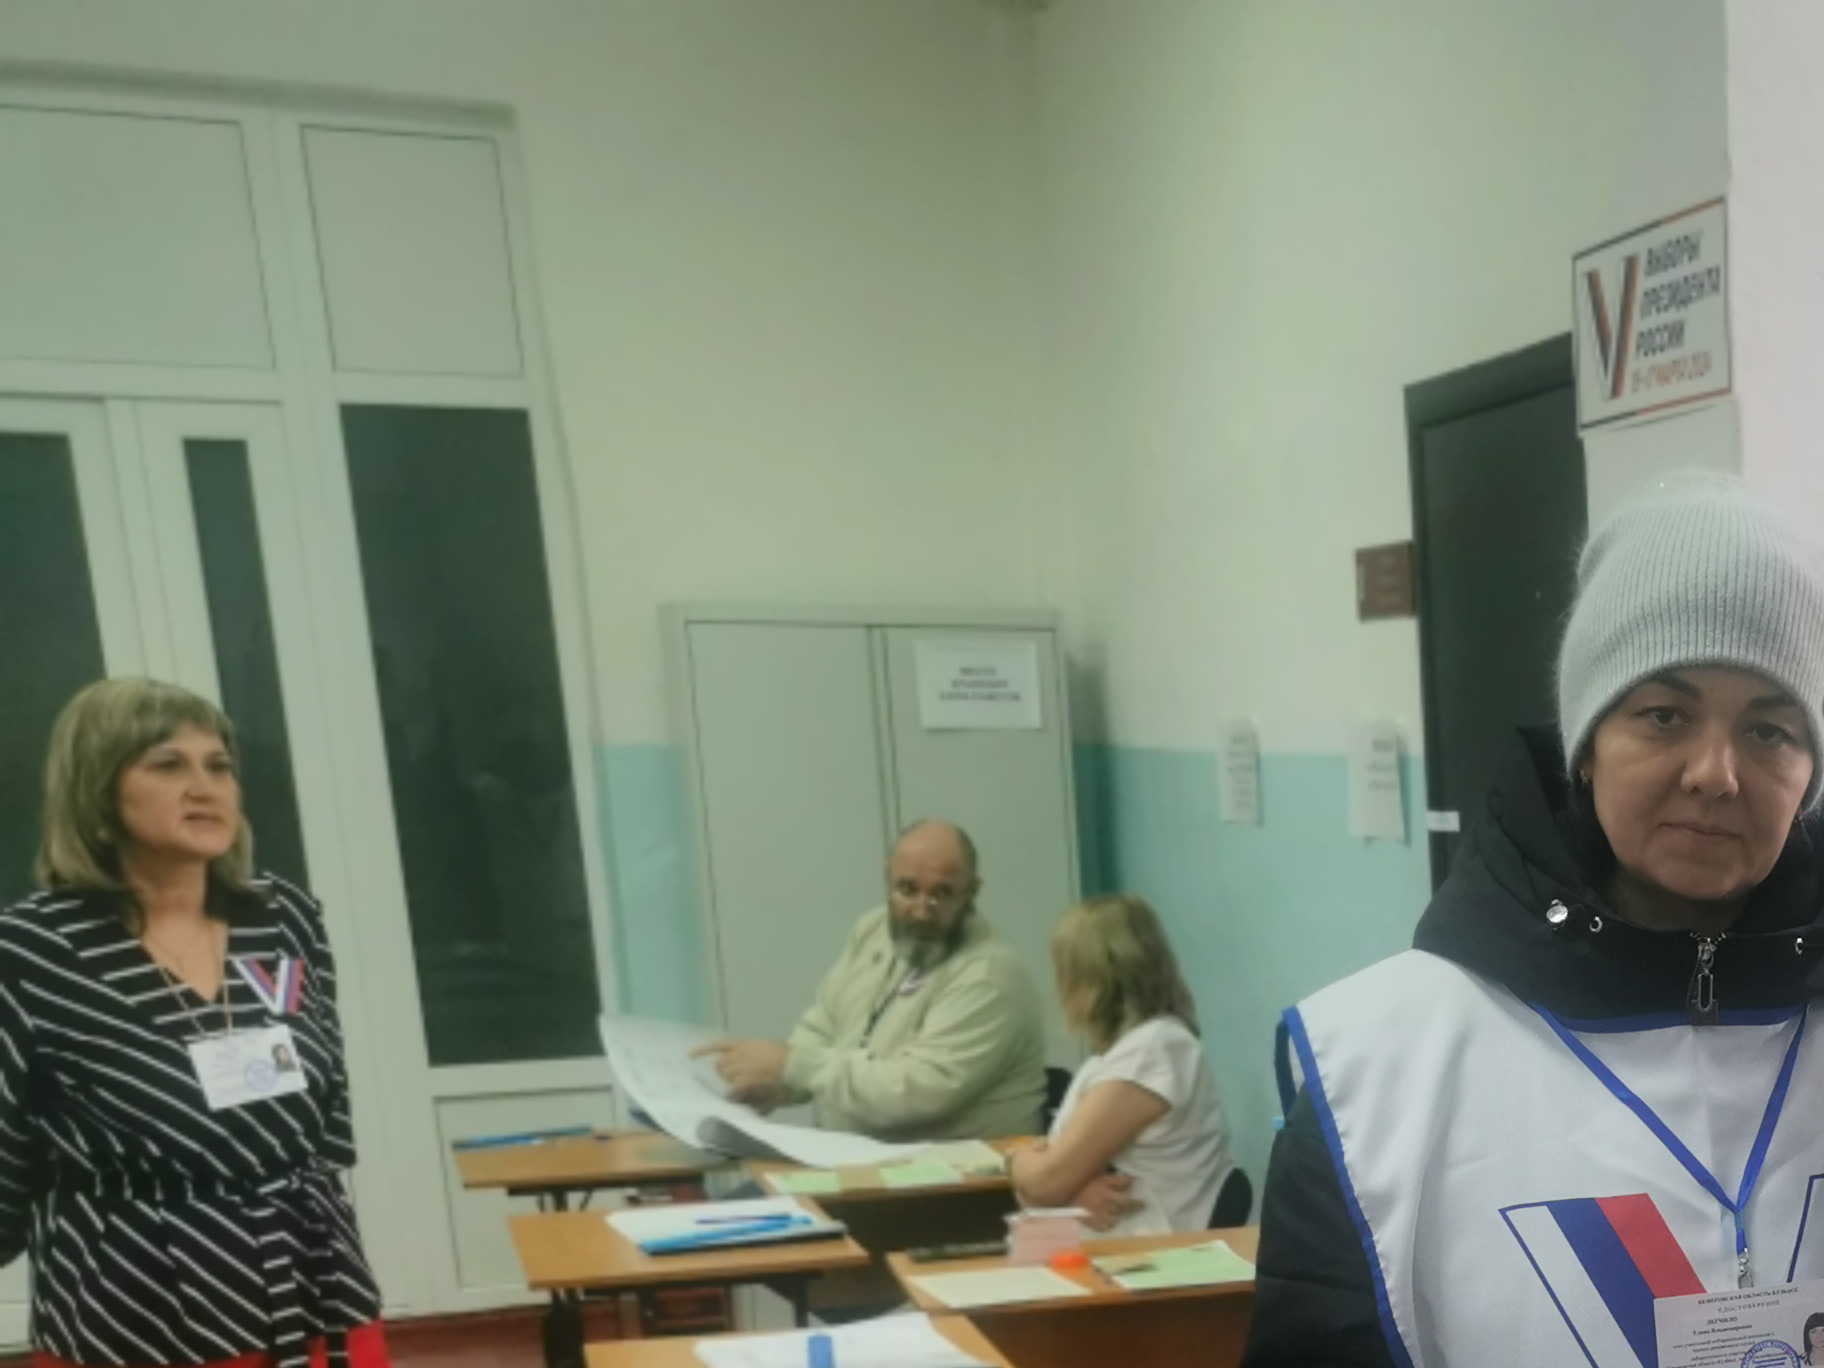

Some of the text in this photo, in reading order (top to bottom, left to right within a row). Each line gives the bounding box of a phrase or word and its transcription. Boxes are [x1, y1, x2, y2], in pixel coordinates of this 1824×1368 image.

[1645, 230, 1702, 277] ВЫБОРЫ
[1640, 264, 1721, 319] ПРЕЗИДЕНТА
[1636, 319, 1686, 359] РОССИИ
